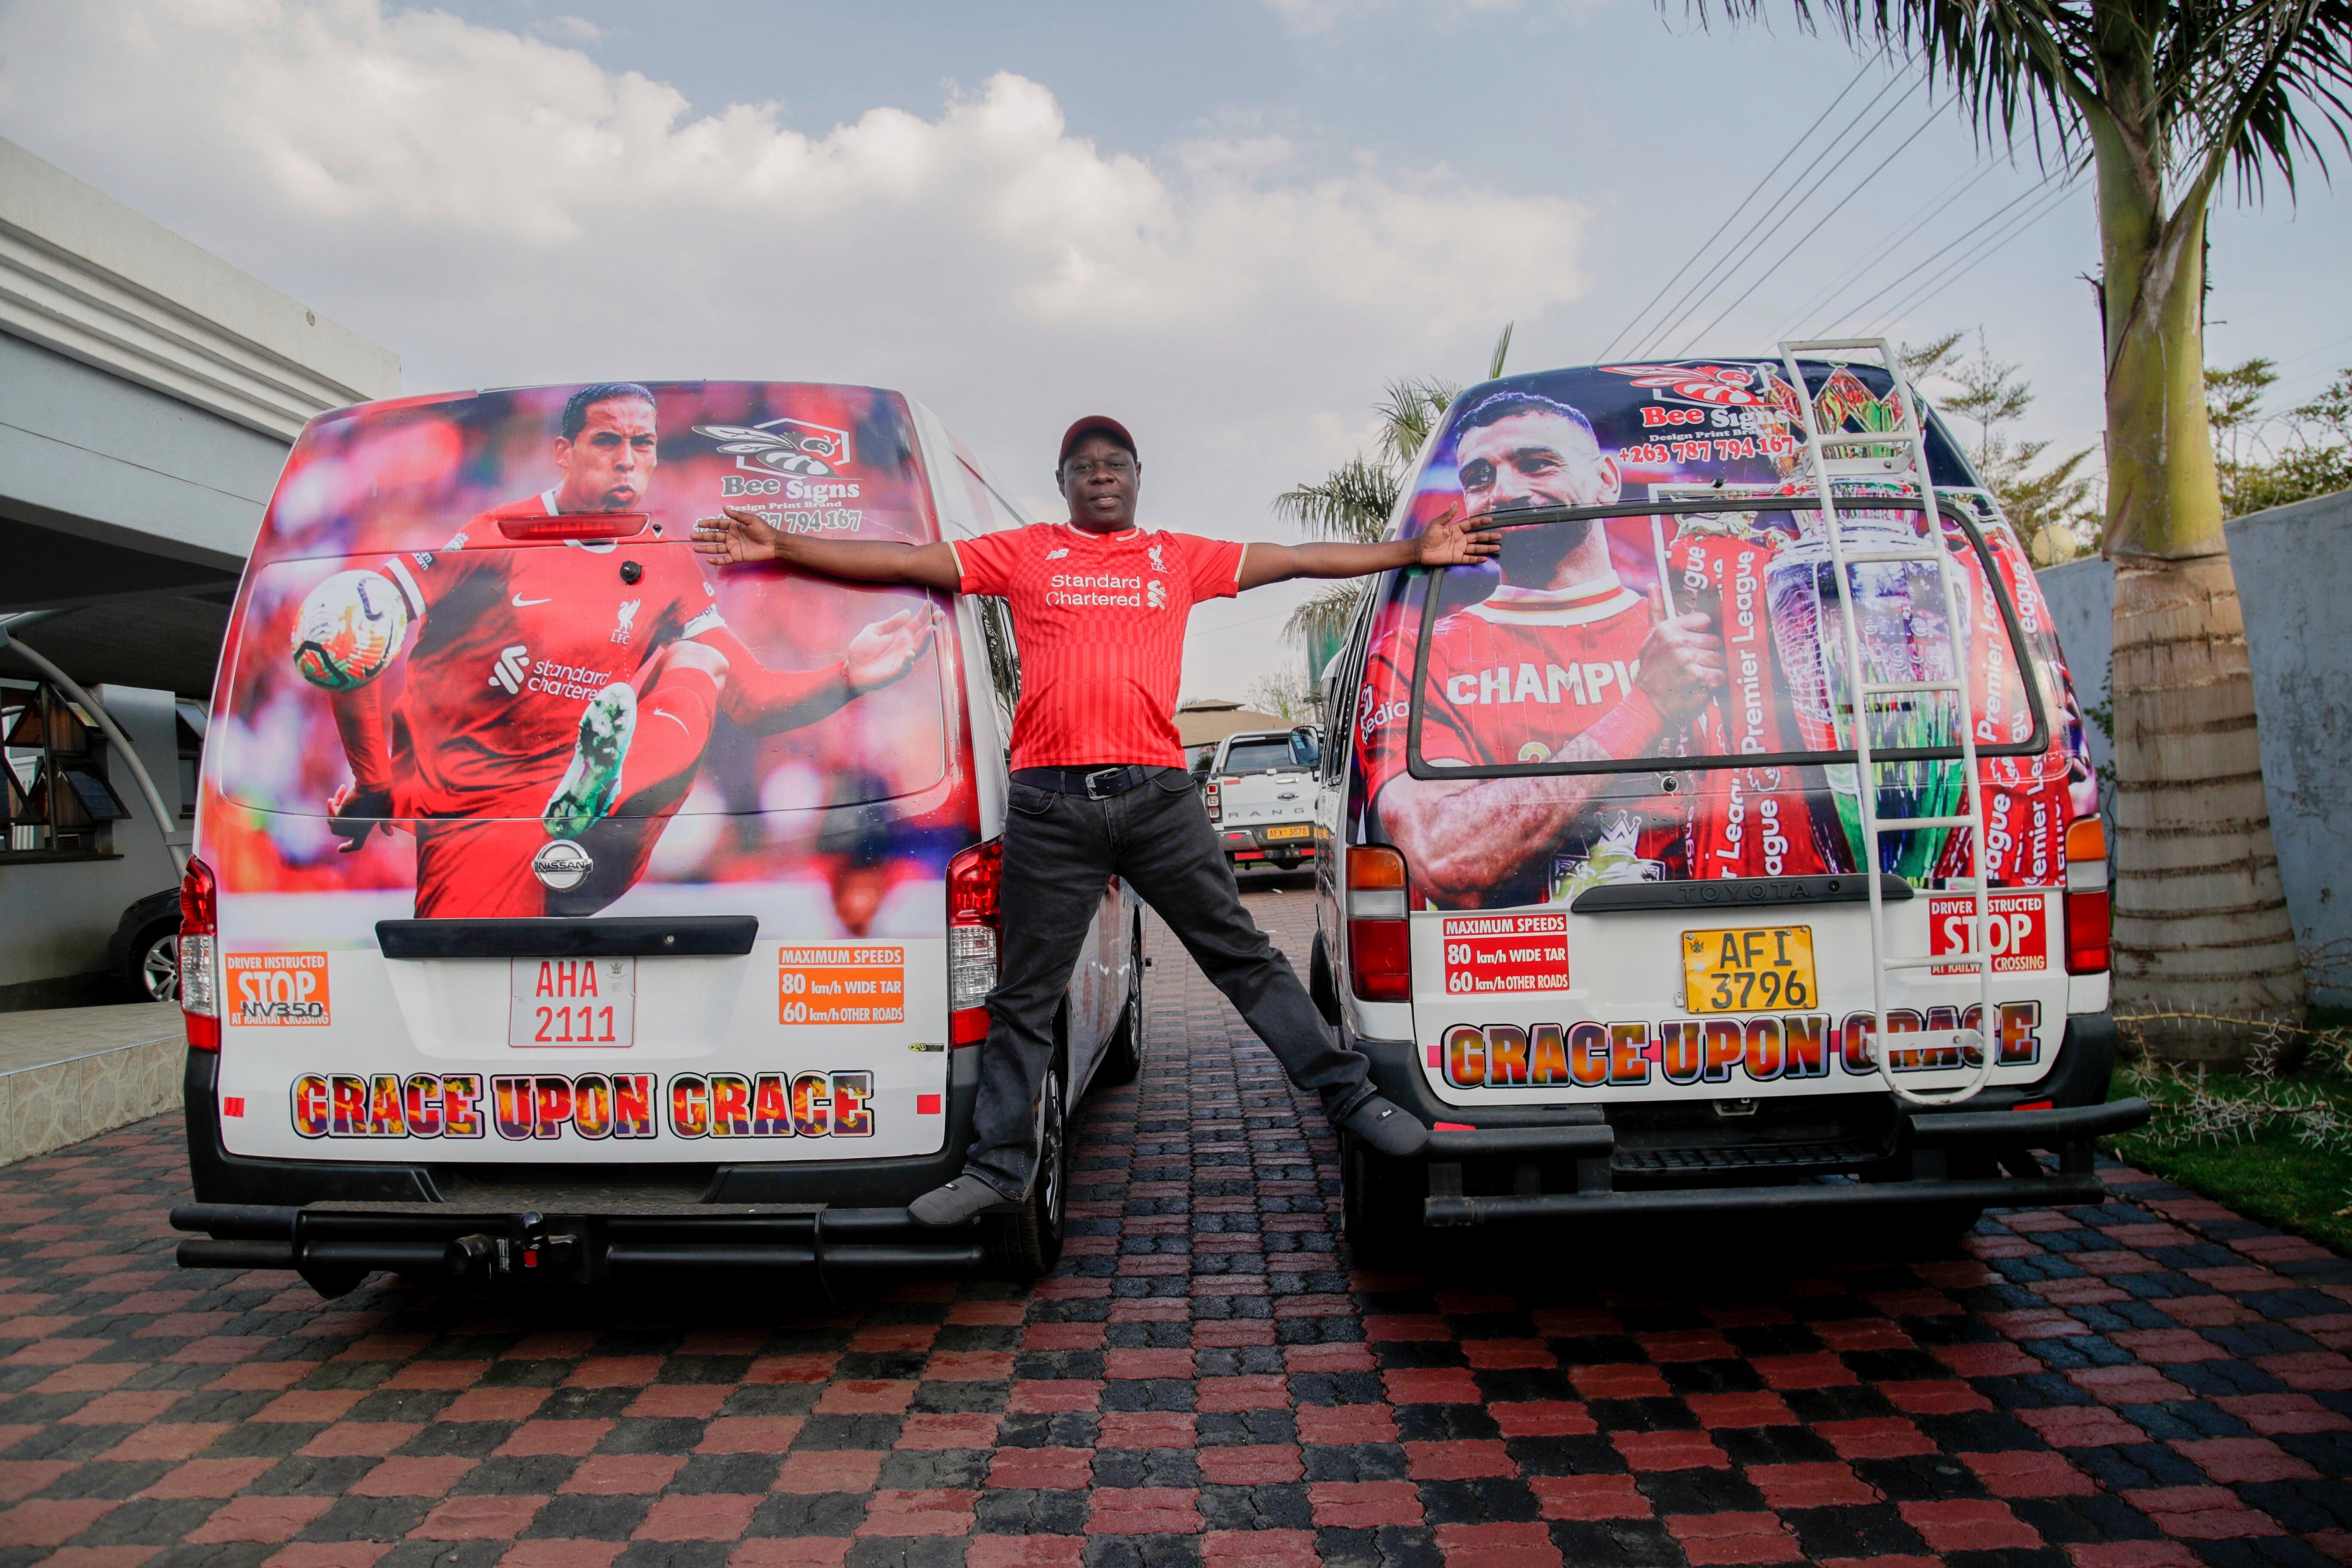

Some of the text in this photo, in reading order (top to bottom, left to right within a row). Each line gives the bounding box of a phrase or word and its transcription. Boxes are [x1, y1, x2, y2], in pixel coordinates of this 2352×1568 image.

[1640, 406, 1790, 430] Bee Signs
[1649, 426, 1773, 442] Design Print Brand
[1619, 435, 1795, 465] +263 787 794 167
[721, 475, 860, 503] Bee Signs
[769, 502, 801, 510] Print
[804, 501, 842, 509] Brand
[784, 511, 824, 534] 794
[822, 509, 862, 532] 167
[1051, 574, 1141, 589] Standard
[1045, 591, 1141, 607] Chartered
[1732, 551, 1765, 755] Premier League
[533, 659, 612, 686] standard
[528, 676, 602, 701] chartere
[1977, 638, 2003, 742] Premier
[1228, 807, 1305, 819] RANG
[1269, 827, 1307, 838] AEX 3878
[1760, 799, 1788, 876] ague
[2028, 800, 2048, 877] emier
[538, 861, 586, 870] NISSAN
[1679, 881, 1812, 902] TOYOTA
[1932, 898, 2042, 915] DRIVER STRUCTED
[1446, 916, 1565, 934] MAXIMUM SPEEDS
[1944, 914, 2032, 956] STOP
[782, 949, 902, 964] MAXIMUM SPEEDS
[1448, 944, 1566, 965] 80 km/h WIDE TAR
[1720, 931, 1792, 969] AFI
[228, 956, 325, 969] DRIVER INSTRUCTED
[1994, 955, 2045, 971] CROSSING
[238, 971, 316, 1008] STOP
[536, 961, 598, 997] AHA
[782, 974, 902, 995] 80 km/h WIDE TAR
[1449, 971, 1568, 992] 60 km/h OTHER ROADS
[1711, 970, 1807, 1009] 3796
[232, 1012, 242, 1025] AT
[241, 1001, 324, 1017] NV350
[783, 1002, 903, 1023] 60 km/h OTHER ROADS
[535, 1006, 616, 1042] 2111
[1441, 1000, 2042, 1090] GRACE UPON GRACE
[291, 1070, 876, 1140] GRACE UPON GRACE
